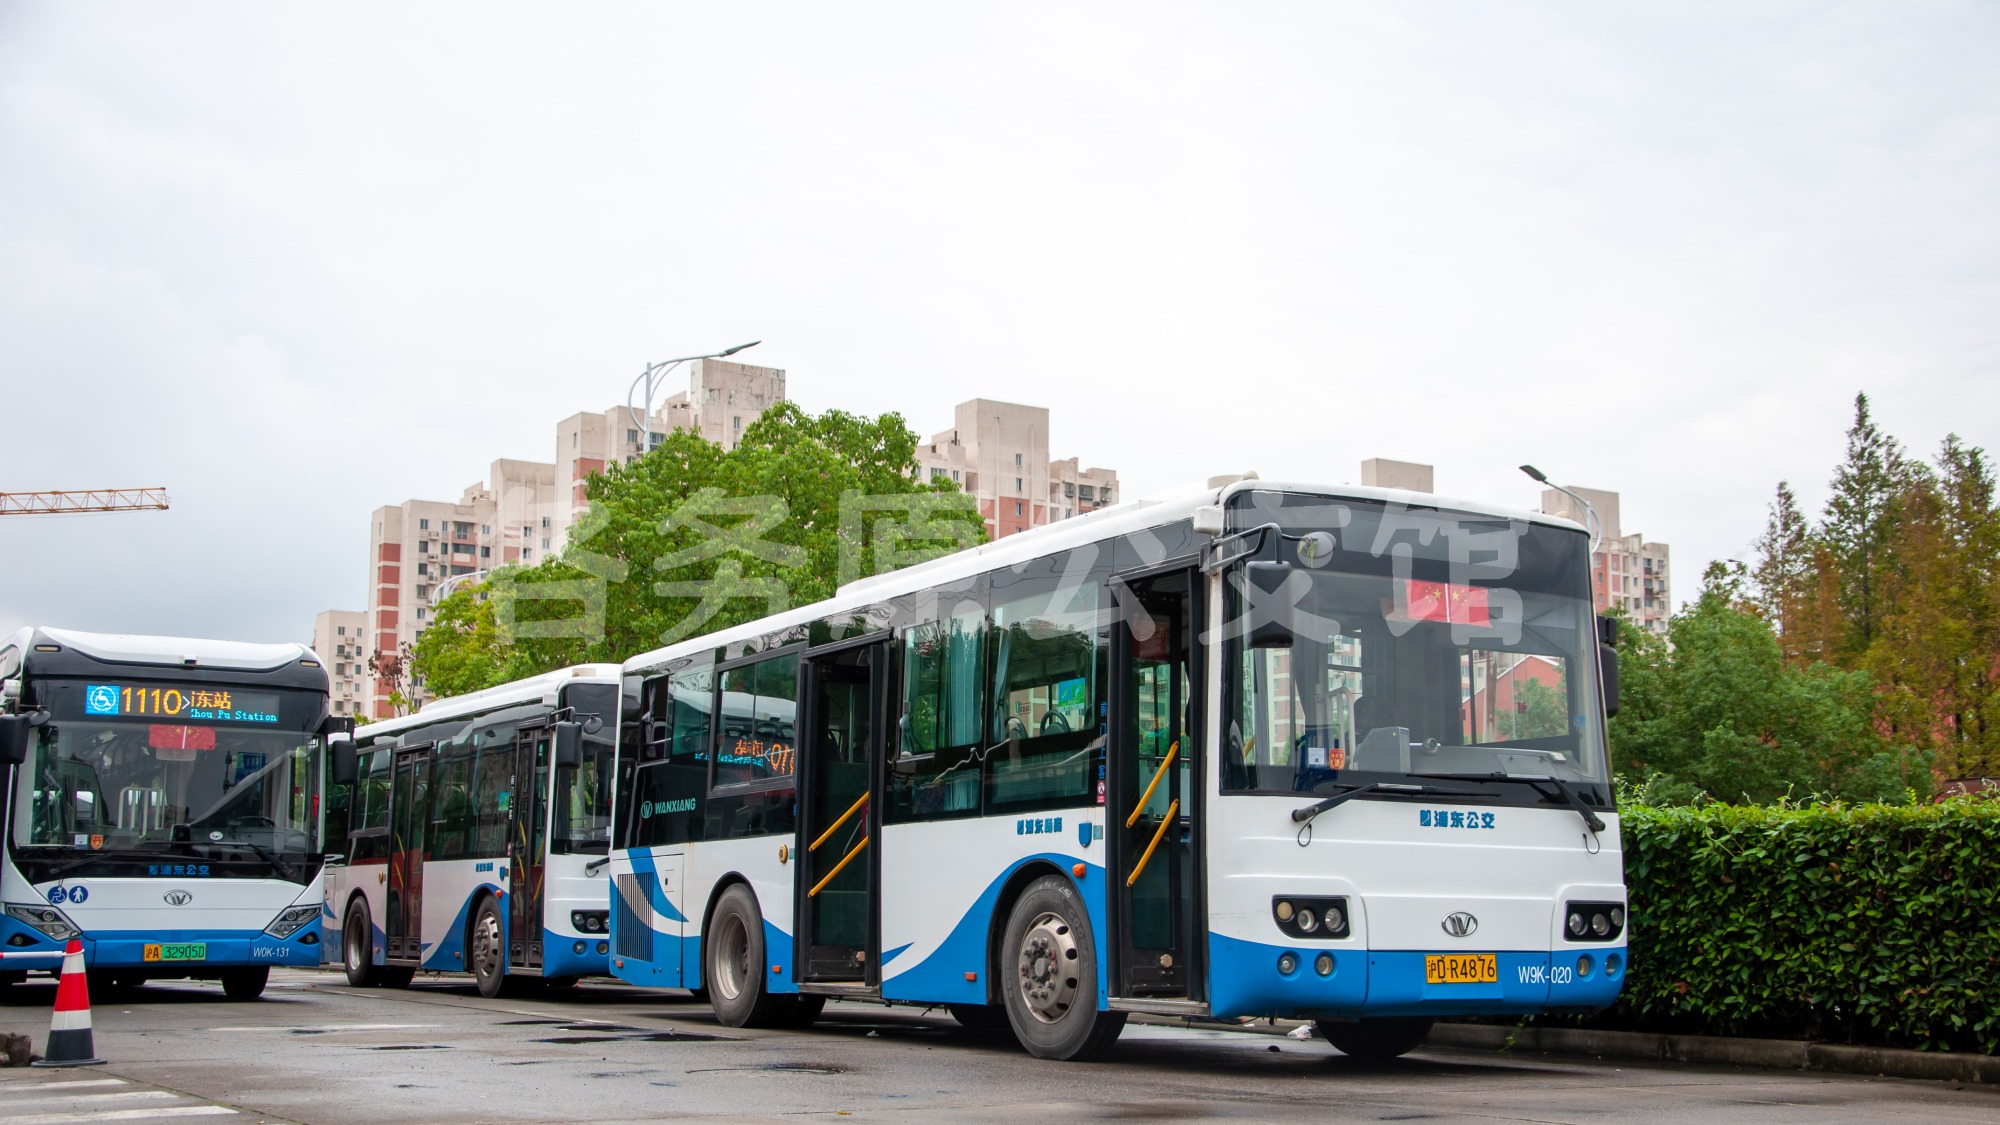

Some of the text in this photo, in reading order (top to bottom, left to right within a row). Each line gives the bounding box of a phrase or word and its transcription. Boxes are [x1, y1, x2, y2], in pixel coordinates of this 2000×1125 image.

[122, 687, 182, 715] 1110
[190, 690, 232, 710] 东站
[217, 709, 231, 719] Pu
[235, 710, 278, 722] Station
[655, 798, 697, 815] WANXIANG
[1434, 810, 1495, 829] 浦东公交
[160, 864, 210, 877] 浦东公交
[1517, 966, 1572, 984] W9K-020
